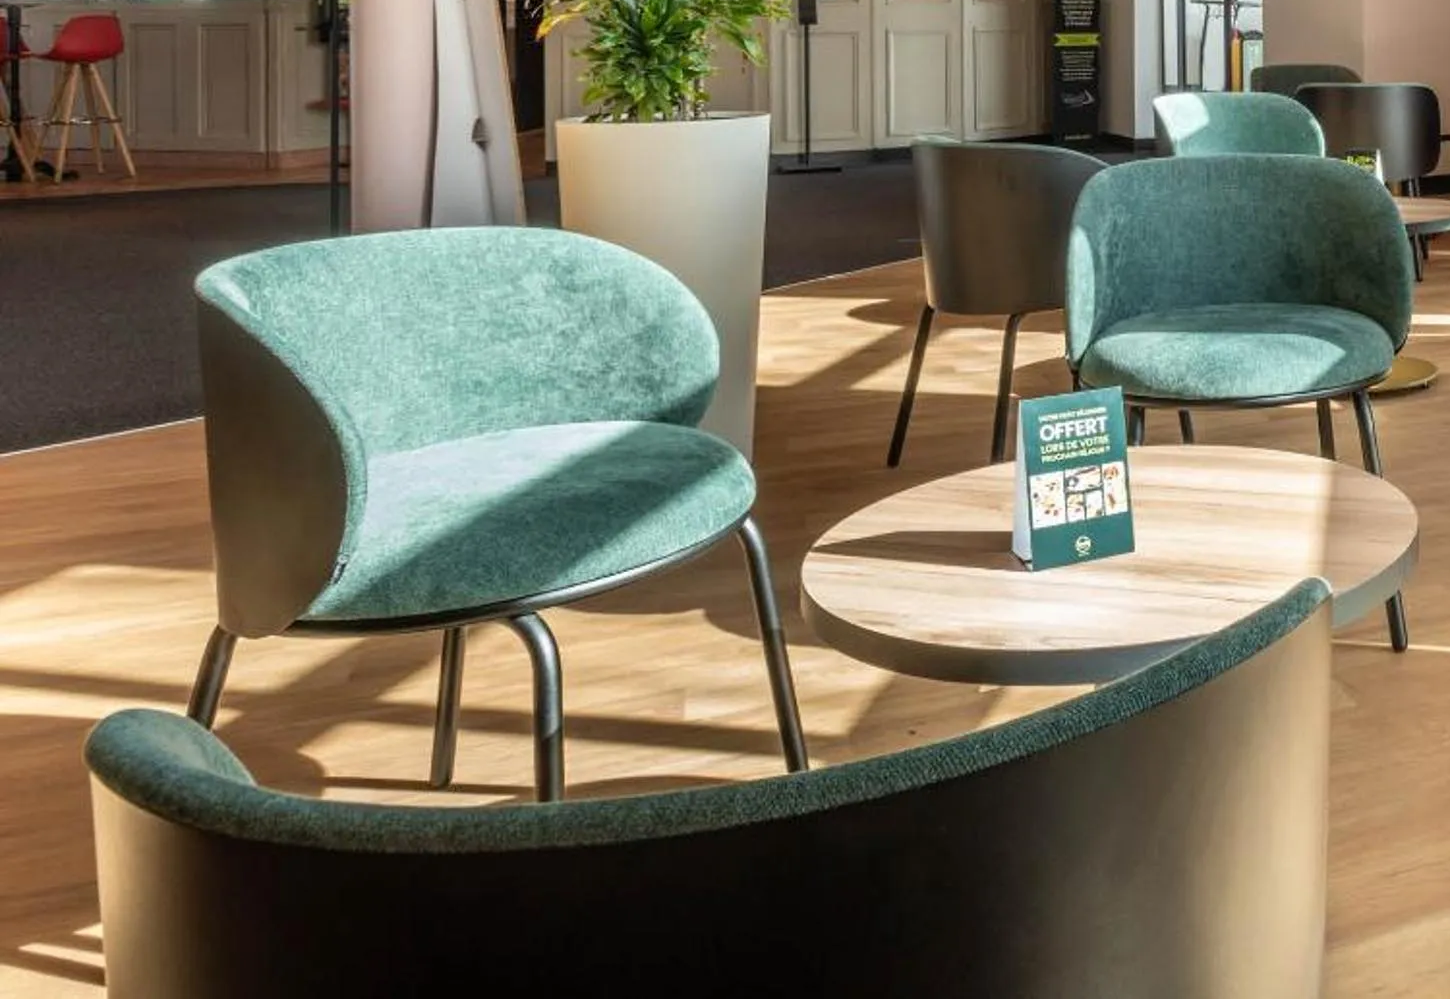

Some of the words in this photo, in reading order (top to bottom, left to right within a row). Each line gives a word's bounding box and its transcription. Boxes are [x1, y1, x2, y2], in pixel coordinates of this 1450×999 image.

[1040, 417, 1107, 441] OFFERT
[1040, 443, 1064, 454] LORS
[1065, 440, 1079, 451] DE
[1079, 435, 1109, 448] VOTRE
